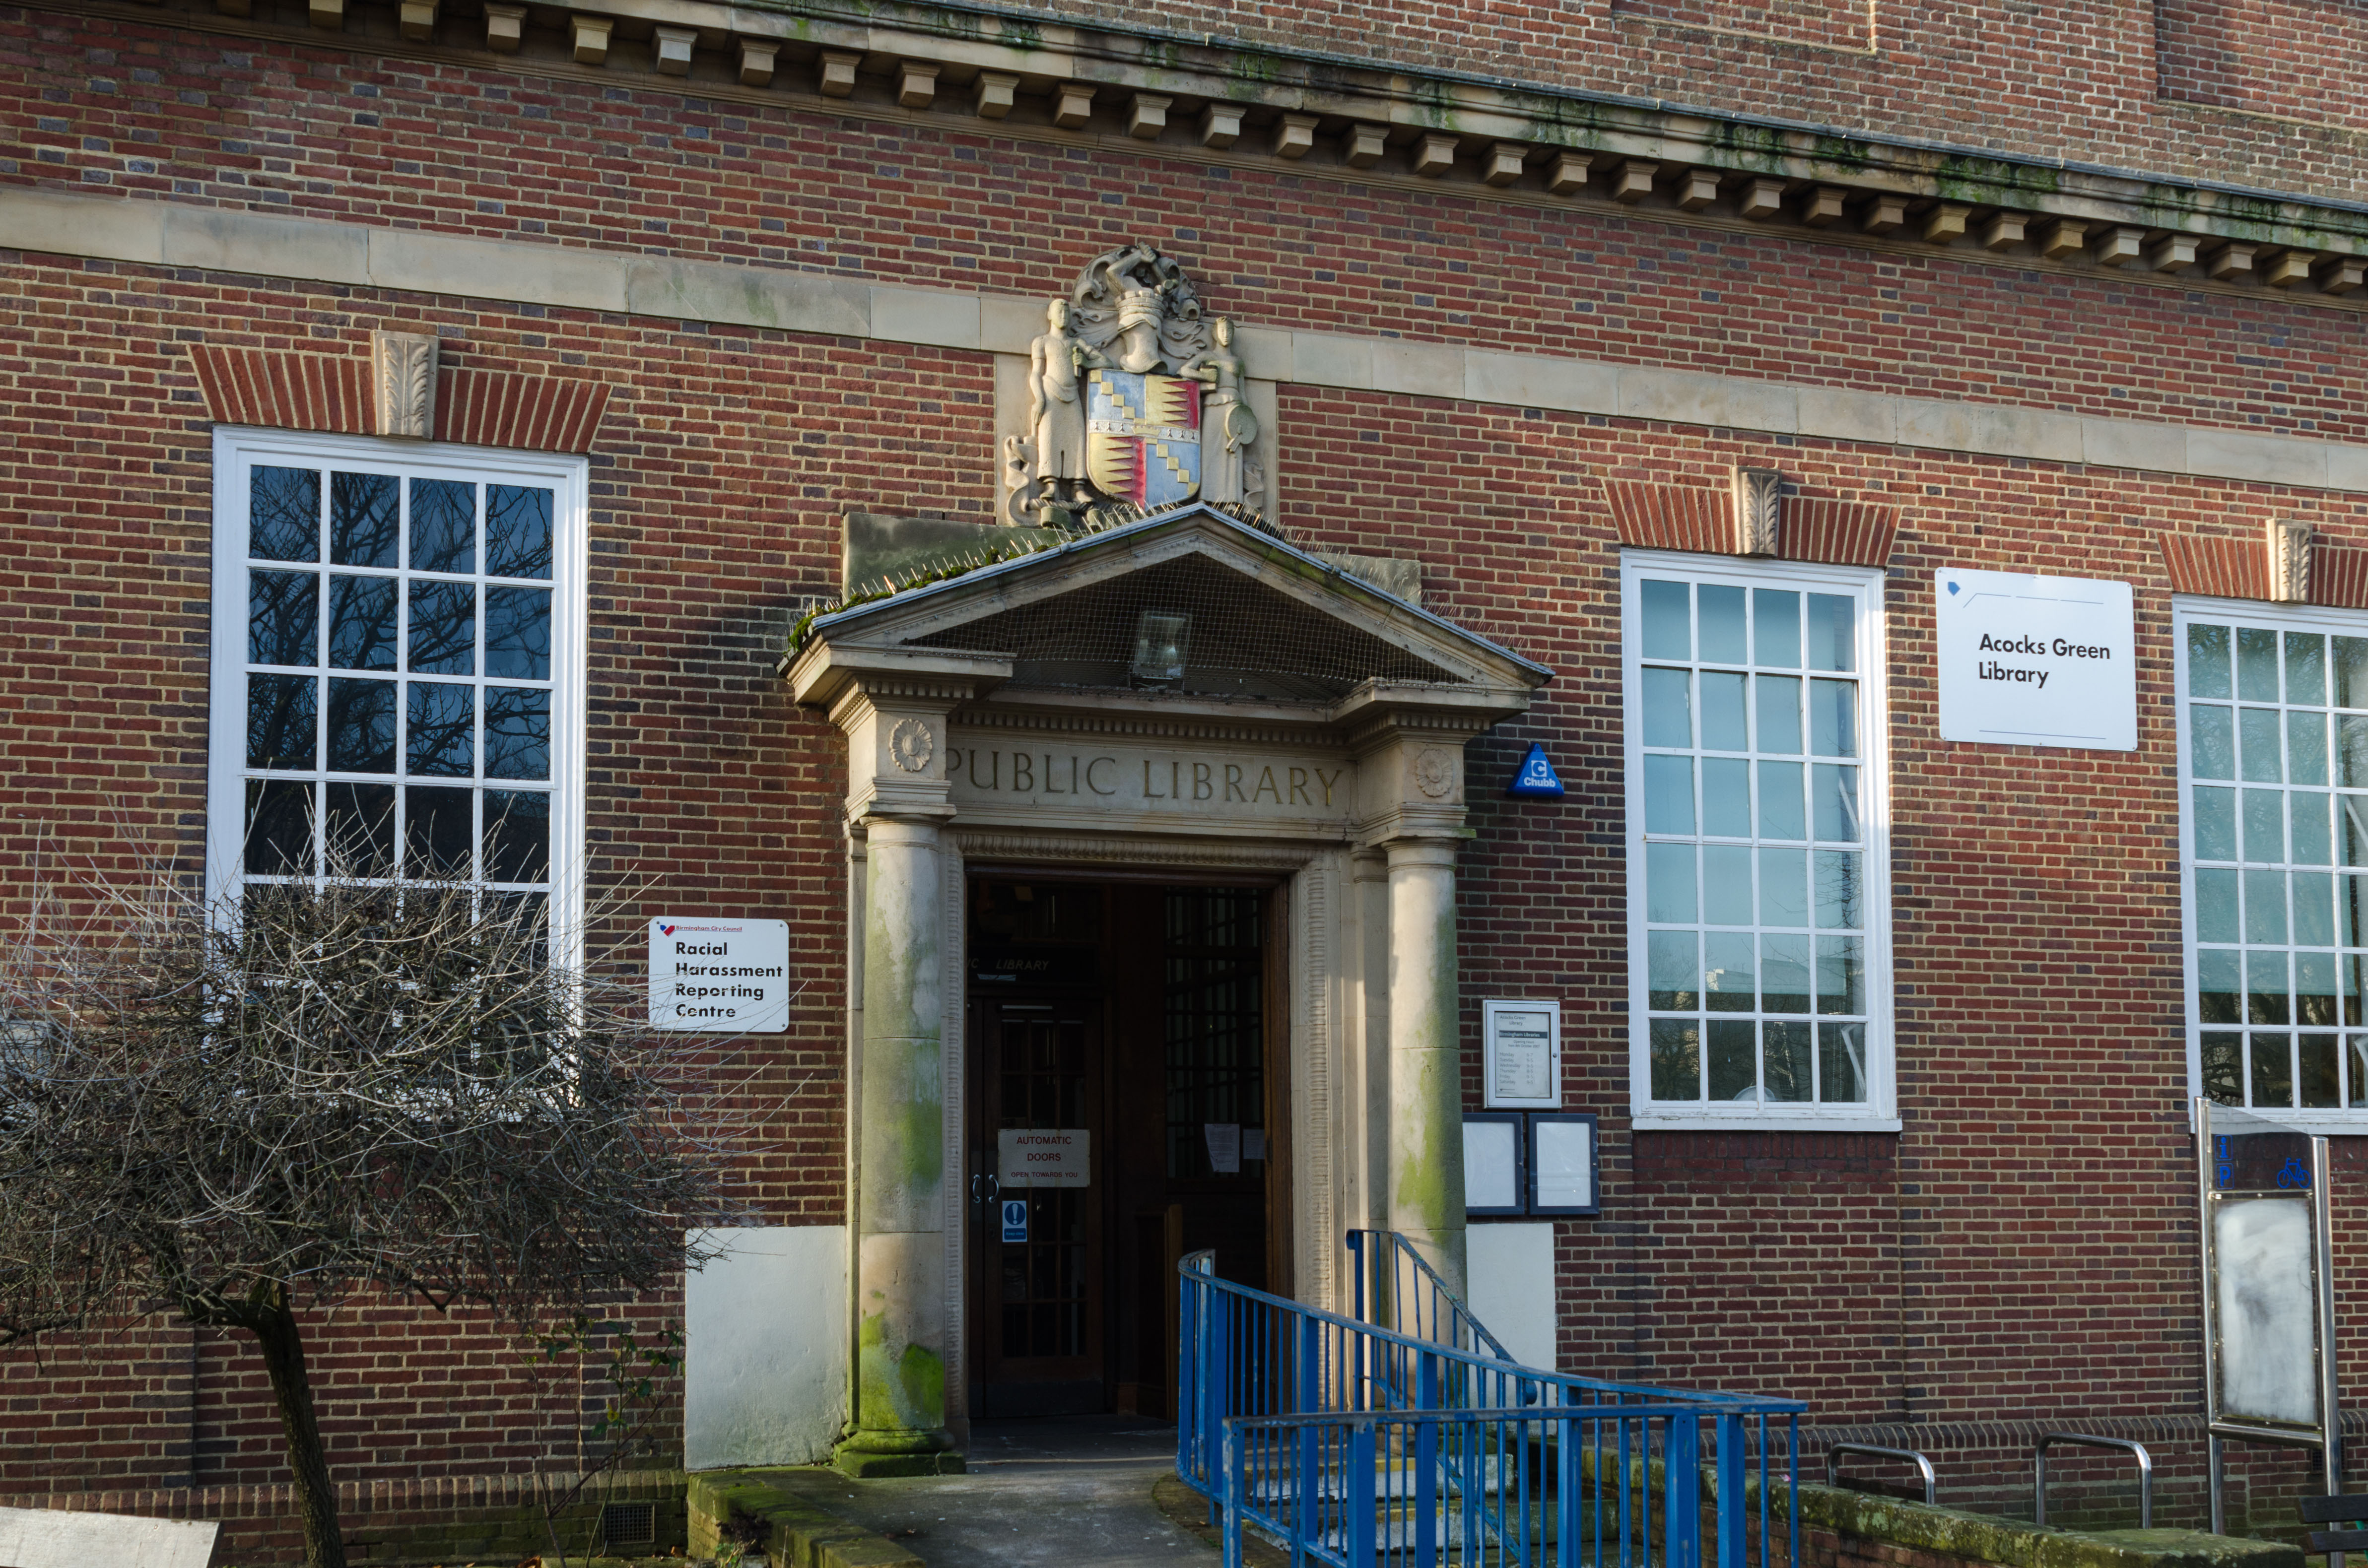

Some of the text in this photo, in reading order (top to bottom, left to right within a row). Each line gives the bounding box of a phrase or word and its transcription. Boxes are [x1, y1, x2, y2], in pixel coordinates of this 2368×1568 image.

[1979, 633, 2110, 659] Acocks Green
[1979, 661, 2049, 689] Library
[946, 748, 1342, 806] PUBLIC LIBRARY
[1524, 777, 1556, 787] Chubb
[676, 942, 728, 955] Racial
[676, 962, 783, 977] Harassment
[995, 958, 1050, 971] LIBRARY
[676, 983, 764, 1000] Reporting
[676, 1004, 736, 1017] Centre
[1016, 1136, 1072, 1145] AUTOMATIC
[1027, 1153, 1061, 1161] DOORS
